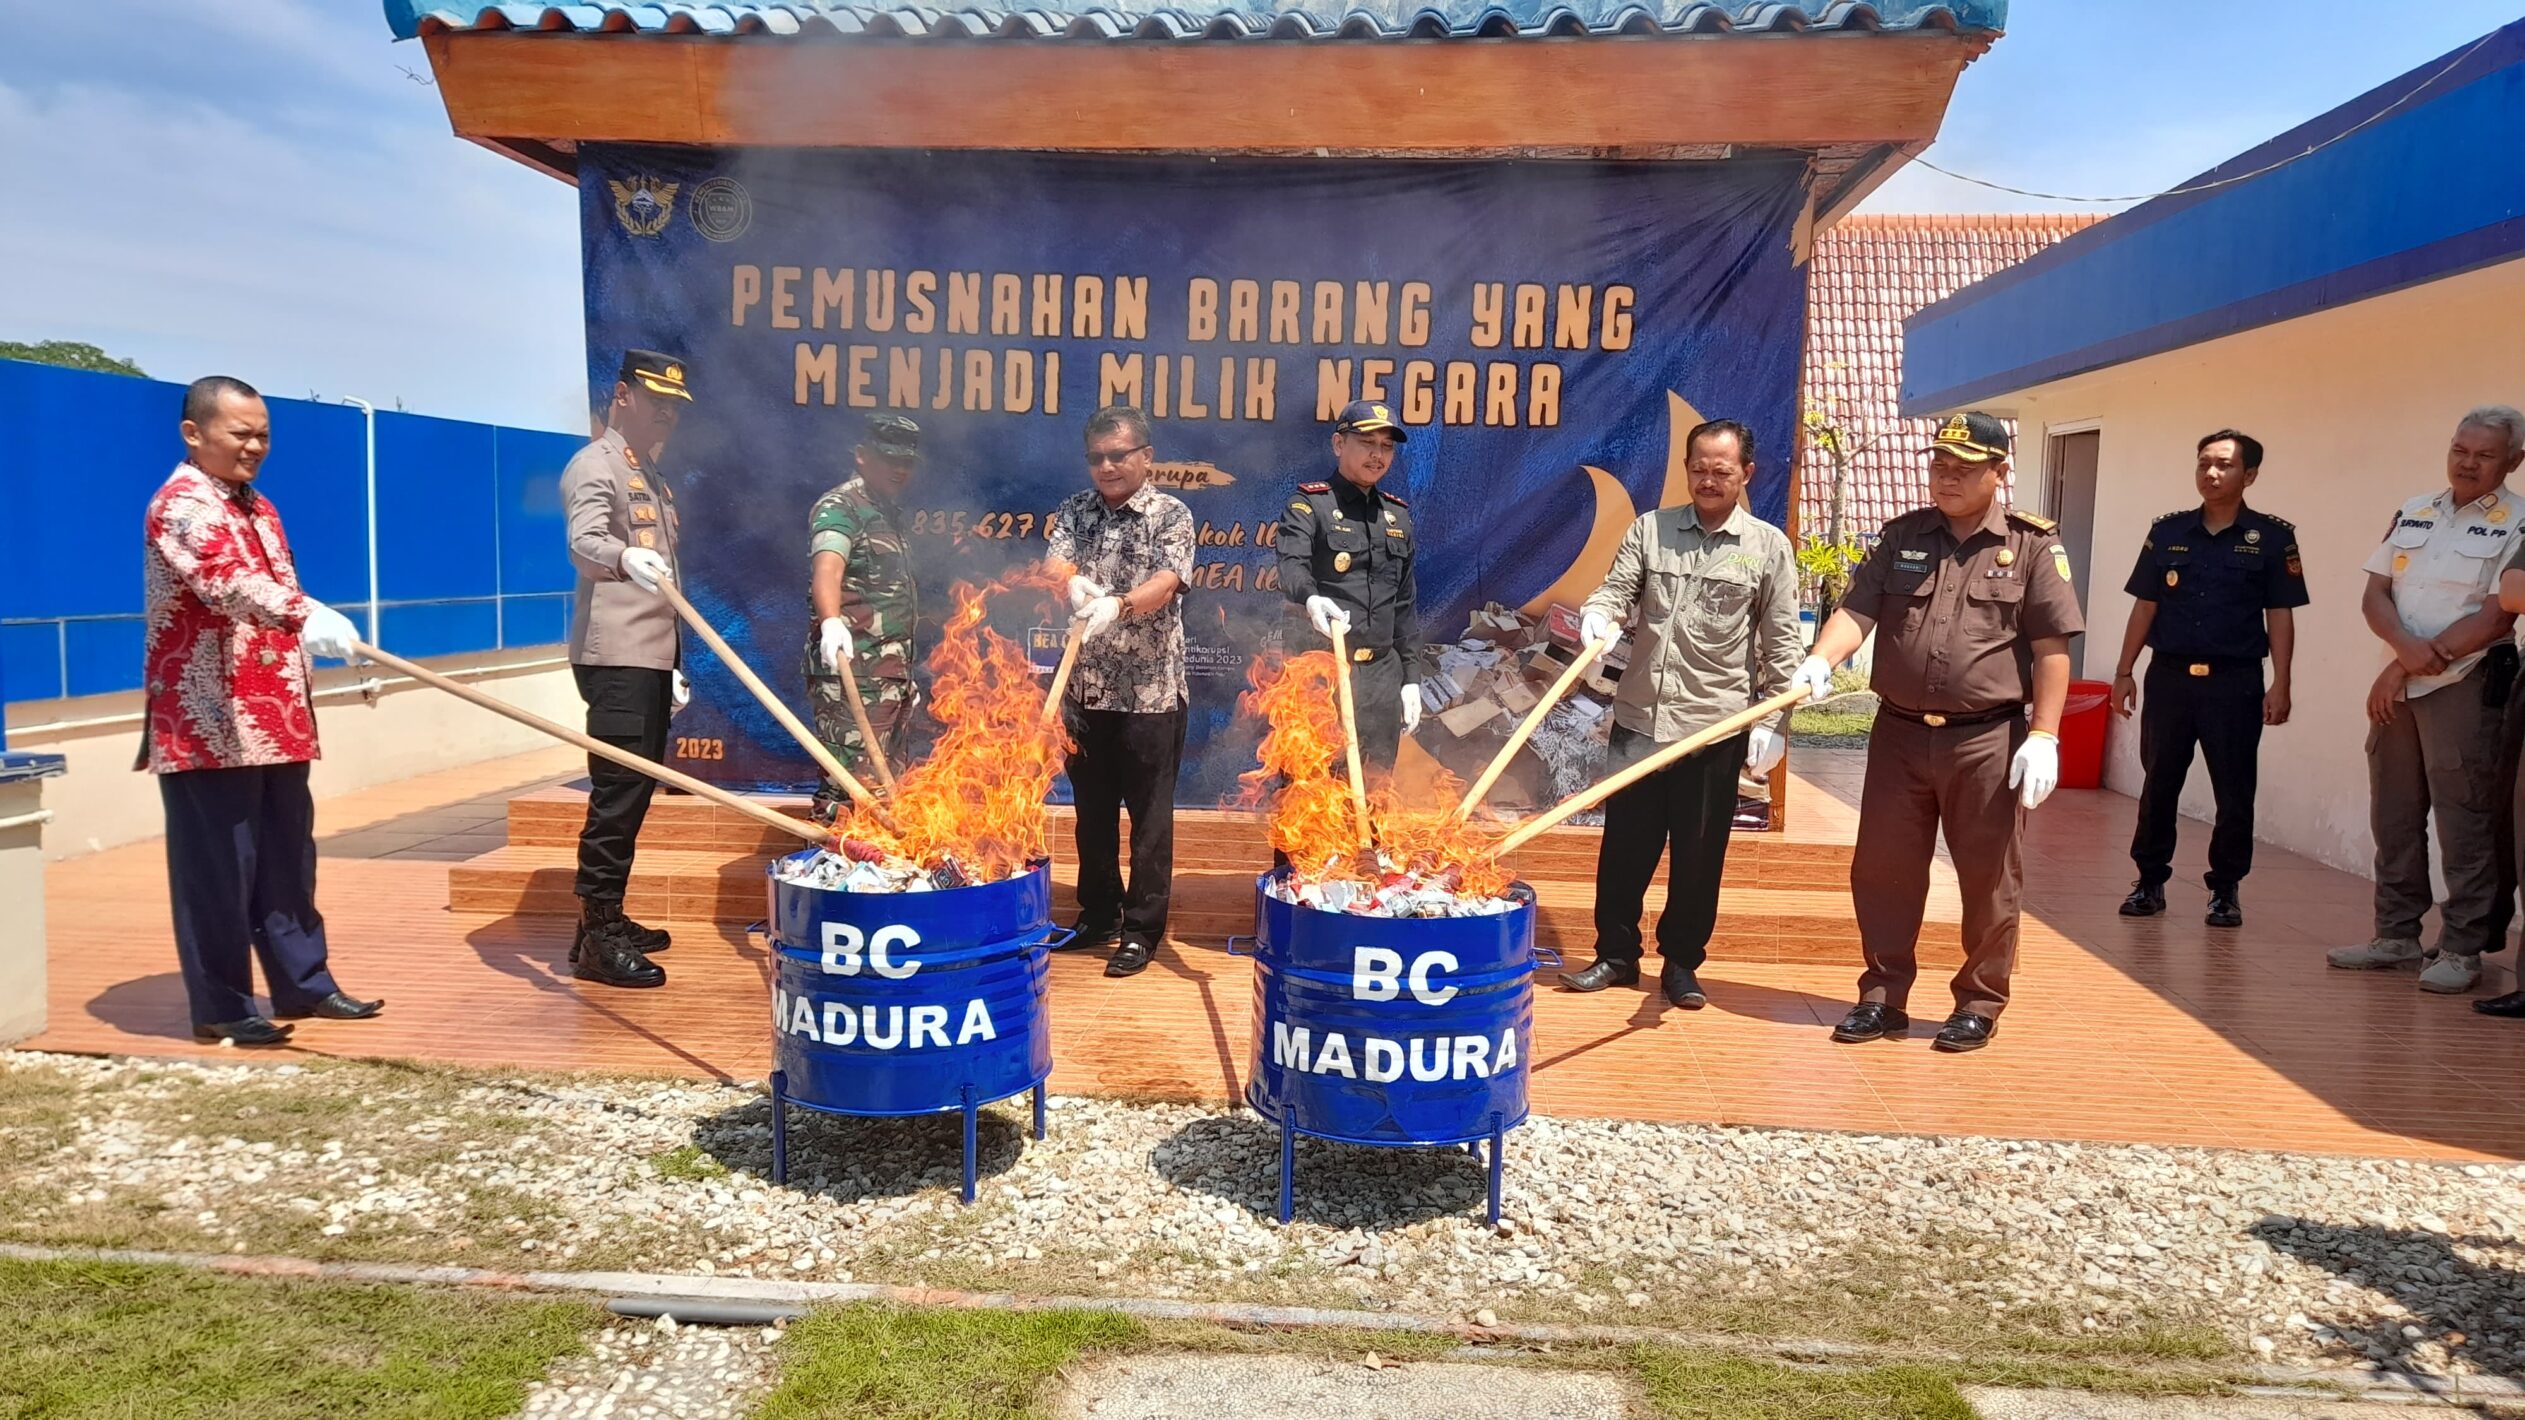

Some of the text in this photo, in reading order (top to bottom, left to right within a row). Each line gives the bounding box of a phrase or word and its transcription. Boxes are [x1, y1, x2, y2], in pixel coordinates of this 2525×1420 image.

[732, 266, 1635, 350] PEMUSNAHAN BARANG YANG
[794, 343, 1561, 427] MENJADI MILIK NEGARA
[1145, 469, 1210, 490] erupa
[1198, 519, 1246, 548] kok
[2466, 526, 2507, 538] POL PP
[1033, 633, 1058, 648] BEA
[1185, 644, 1230, 656] ntikorupsi
[1184, 654, 1242, 665] edunia 2023
[676, 736, 724, 760] 2023
[821, 921, 922, 980] BC
[1352, 946, 1459, 1006] BC
[772, 983, 997, 1050] MADURA
[1273, 1021, 1517, 1083] MADURA
